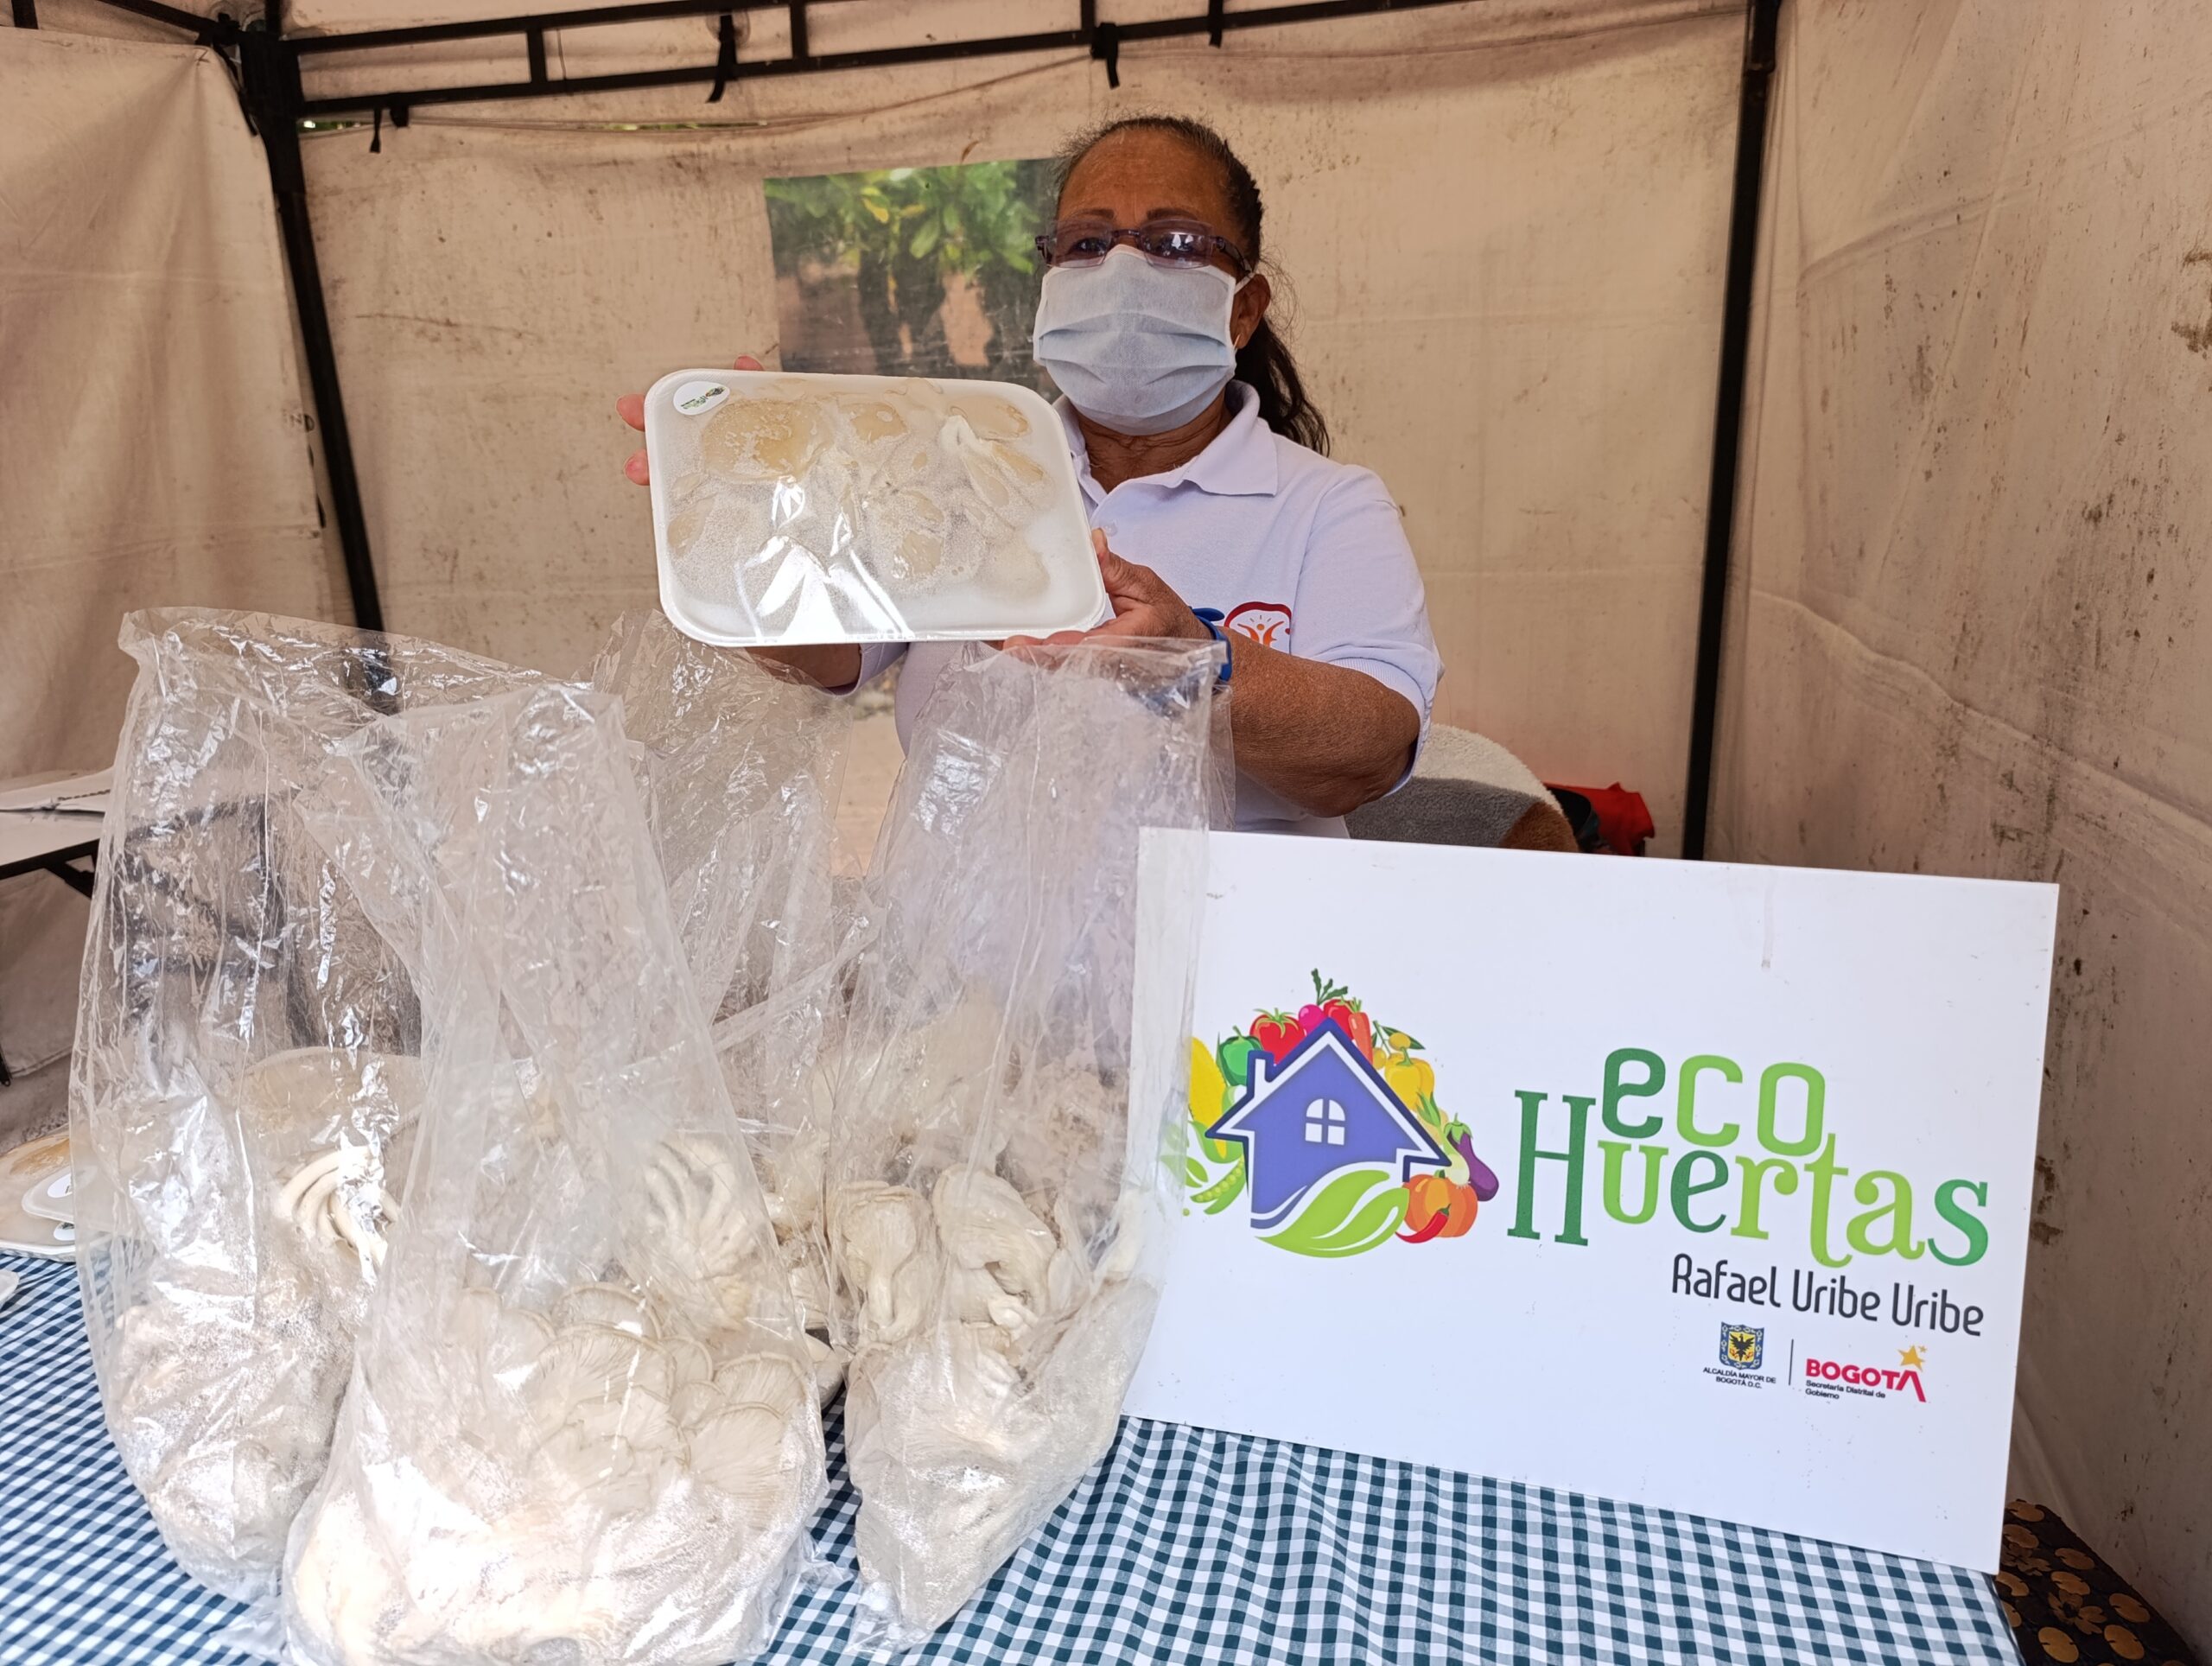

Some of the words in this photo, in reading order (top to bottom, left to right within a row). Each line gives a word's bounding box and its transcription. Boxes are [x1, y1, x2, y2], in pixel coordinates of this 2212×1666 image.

[1601, 1047, 1827, 1157] eco
[1506, 1089, 1990, 1269] Huertas
[1672, 1253, 1781, 1308] Rafael
[1791, 1269, 1880, 1322] Uribe
[1891, 1282, 1985, 1338] Uribe
[1738, 1372, 1764, 1383] MAYOR
[1765, 1376, 1777, 1384] DE
[1805, 1388, 1840, 1400] Gobierno
[1846, 1385, 1874, 1397] Distrital
[1875, 1389, 1886, 1399] de
